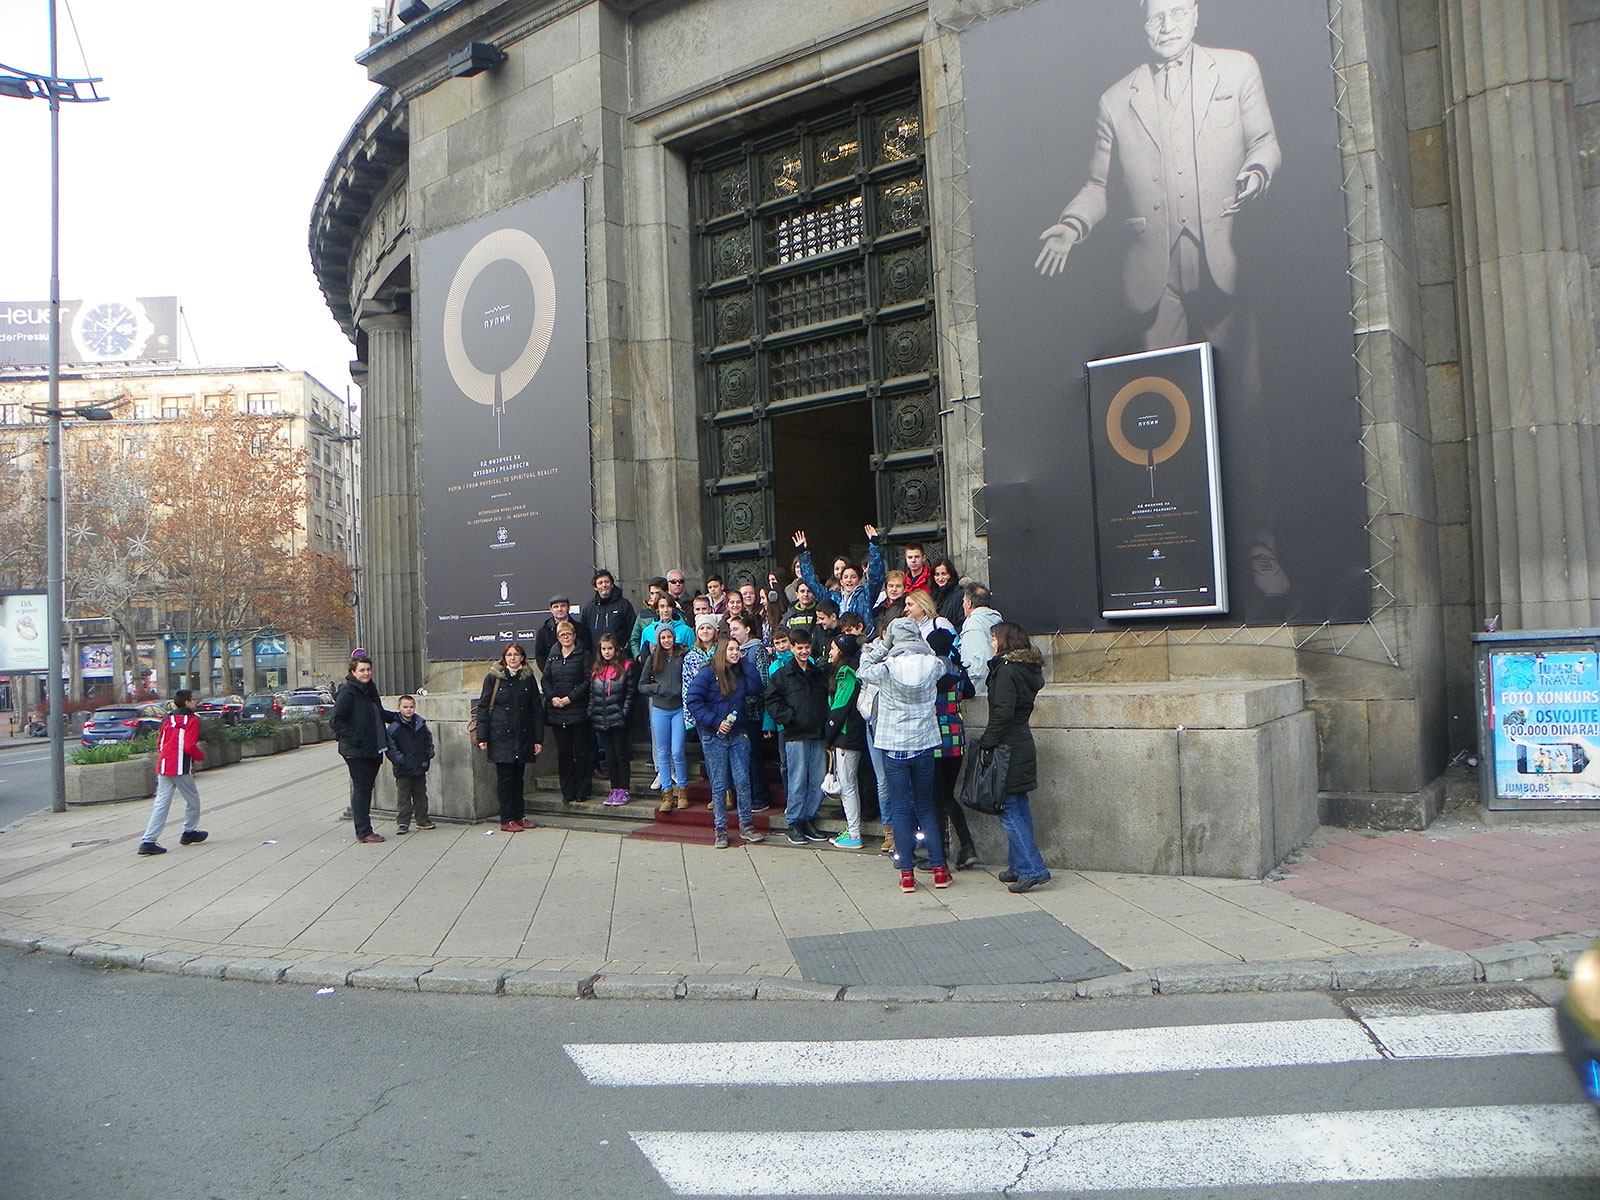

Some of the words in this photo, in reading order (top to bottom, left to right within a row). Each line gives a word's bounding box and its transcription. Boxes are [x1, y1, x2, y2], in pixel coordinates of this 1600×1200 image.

[1540, 675, 1584, 686] TRAVEL
[1502, 691, 1533, 705] FOTO
[1536, 690, 1599, 704] KONKURS
[1536, 709, 1599, 723] OSVOJITE
[1503, 725, 1548, 736] 100.000
[1551, 724, 1599, 736] DINARA!
[1504, 783, 1550, 792] JUMBO.RS
